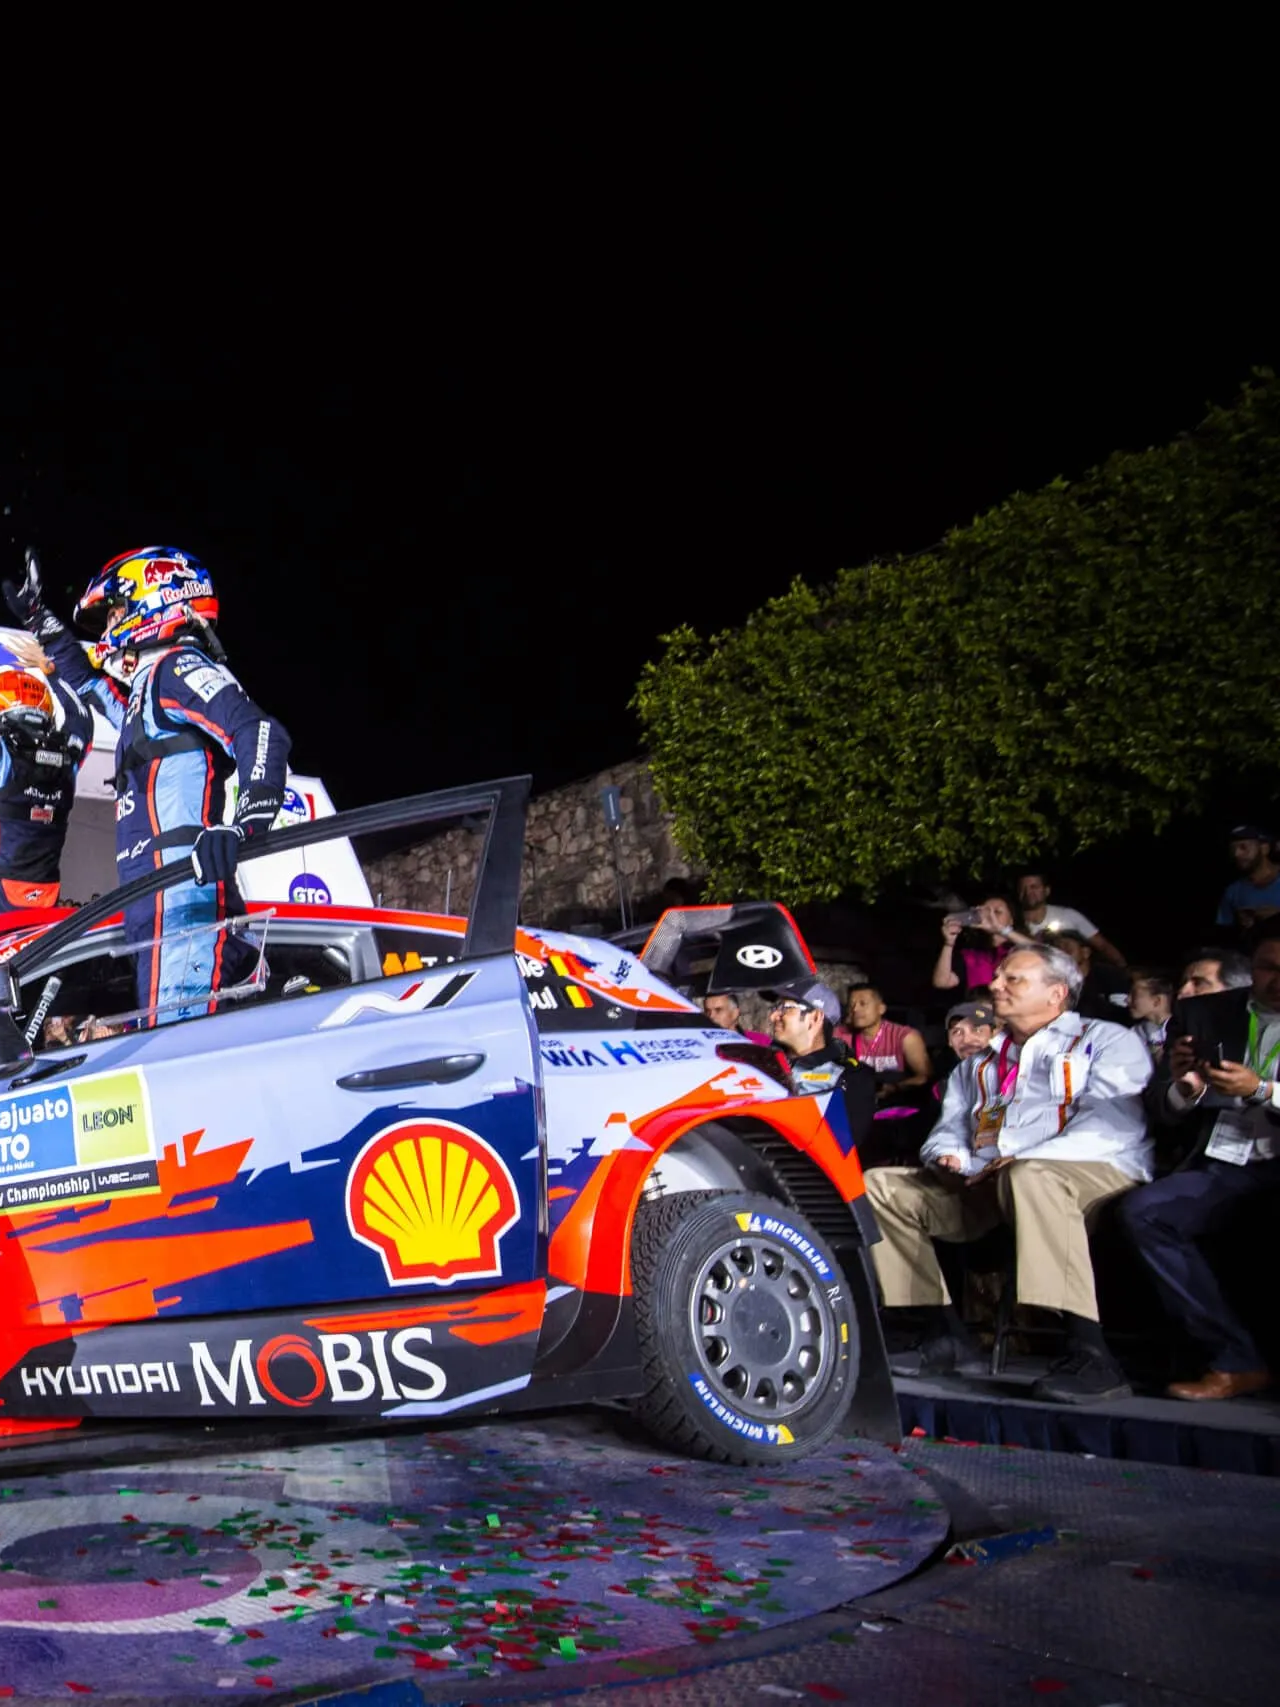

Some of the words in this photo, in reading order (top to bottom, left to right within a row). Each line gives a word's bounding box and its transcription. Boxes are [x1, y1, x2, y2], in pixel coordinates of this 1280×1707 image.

[7, 1176, 90, 1203] Championship
[763, 1217, 830, 1276] MICHELIN
[20, 1361, 180, 1396] HYUNDAI
[190, 1326, 448, 1407] MOBIS
[693, 1379, 764, 1440] MICHELIN
